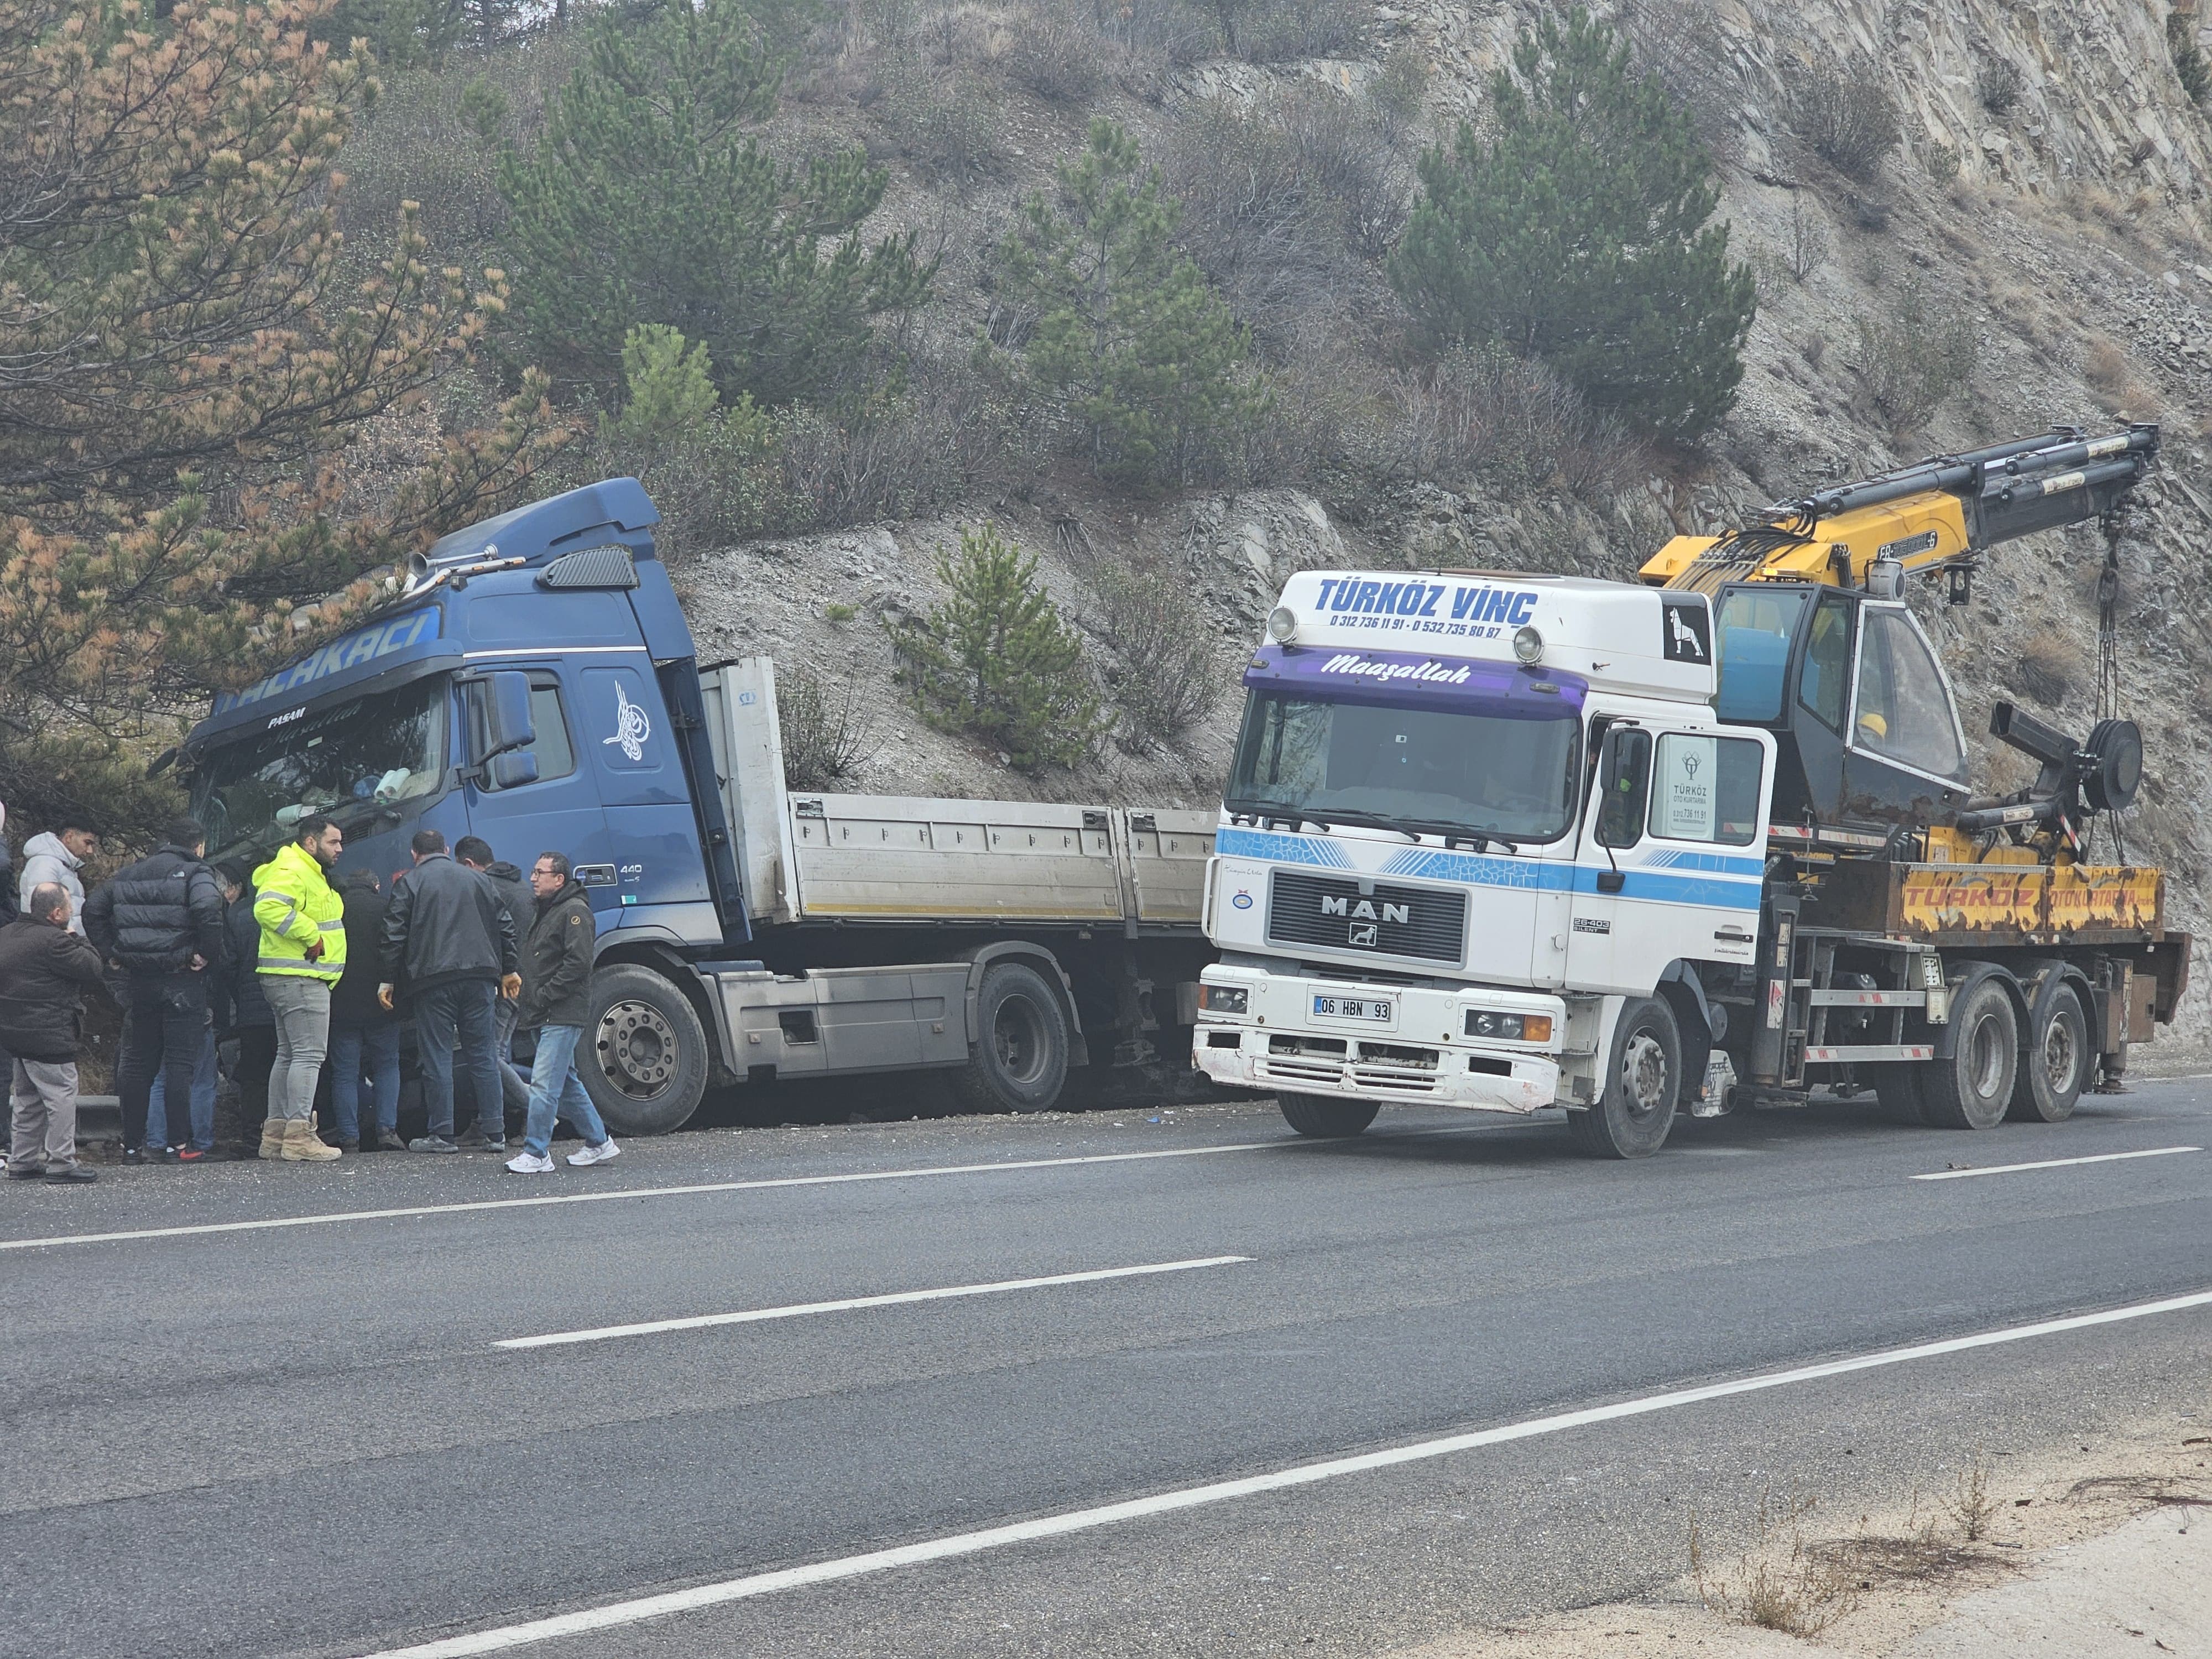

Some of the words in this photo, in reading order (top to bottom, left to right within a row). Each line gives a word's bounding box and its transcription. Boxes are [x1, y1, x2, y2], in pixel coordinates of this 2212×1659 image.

[1316, 576, 1446, 617] TÜRKÖZ
[1451, 585, 1538, 628] VİNÇ
[1330, 615, 1337, 625] 0
[1339, 616, 1357, 627] 312
[1359, 617, 1379, 628] 736
[1381, 618, 1390, 629] 11
[1391, 619, 1405, 629] 91
[1412, 620, 1420, 631] 0
[1422, 621, 1444, 633] 532
[1446, 623, 1467, 635] 735
[1469, 625, 1484, 637] 80
[1486, 627, 1501, 638] 87
[1321, 654, 1472, 684] Maaşallah
[1674, 783, 1707, 796] TÜRKÖZ
[1694, 810, 1699, 818] 11
[1700, 810, 1706, 819] 91
[620, 864, 642, 874] 440
[1906, 878, 2034, 906] TÜRKÖZ
[1322, 896, 1409, 924] MAN
[1322, 999, 1335, 1013] 06
[1343, 1001, 1363, 1016] HBN
[1375, 1004, 1388, 1018] 93
